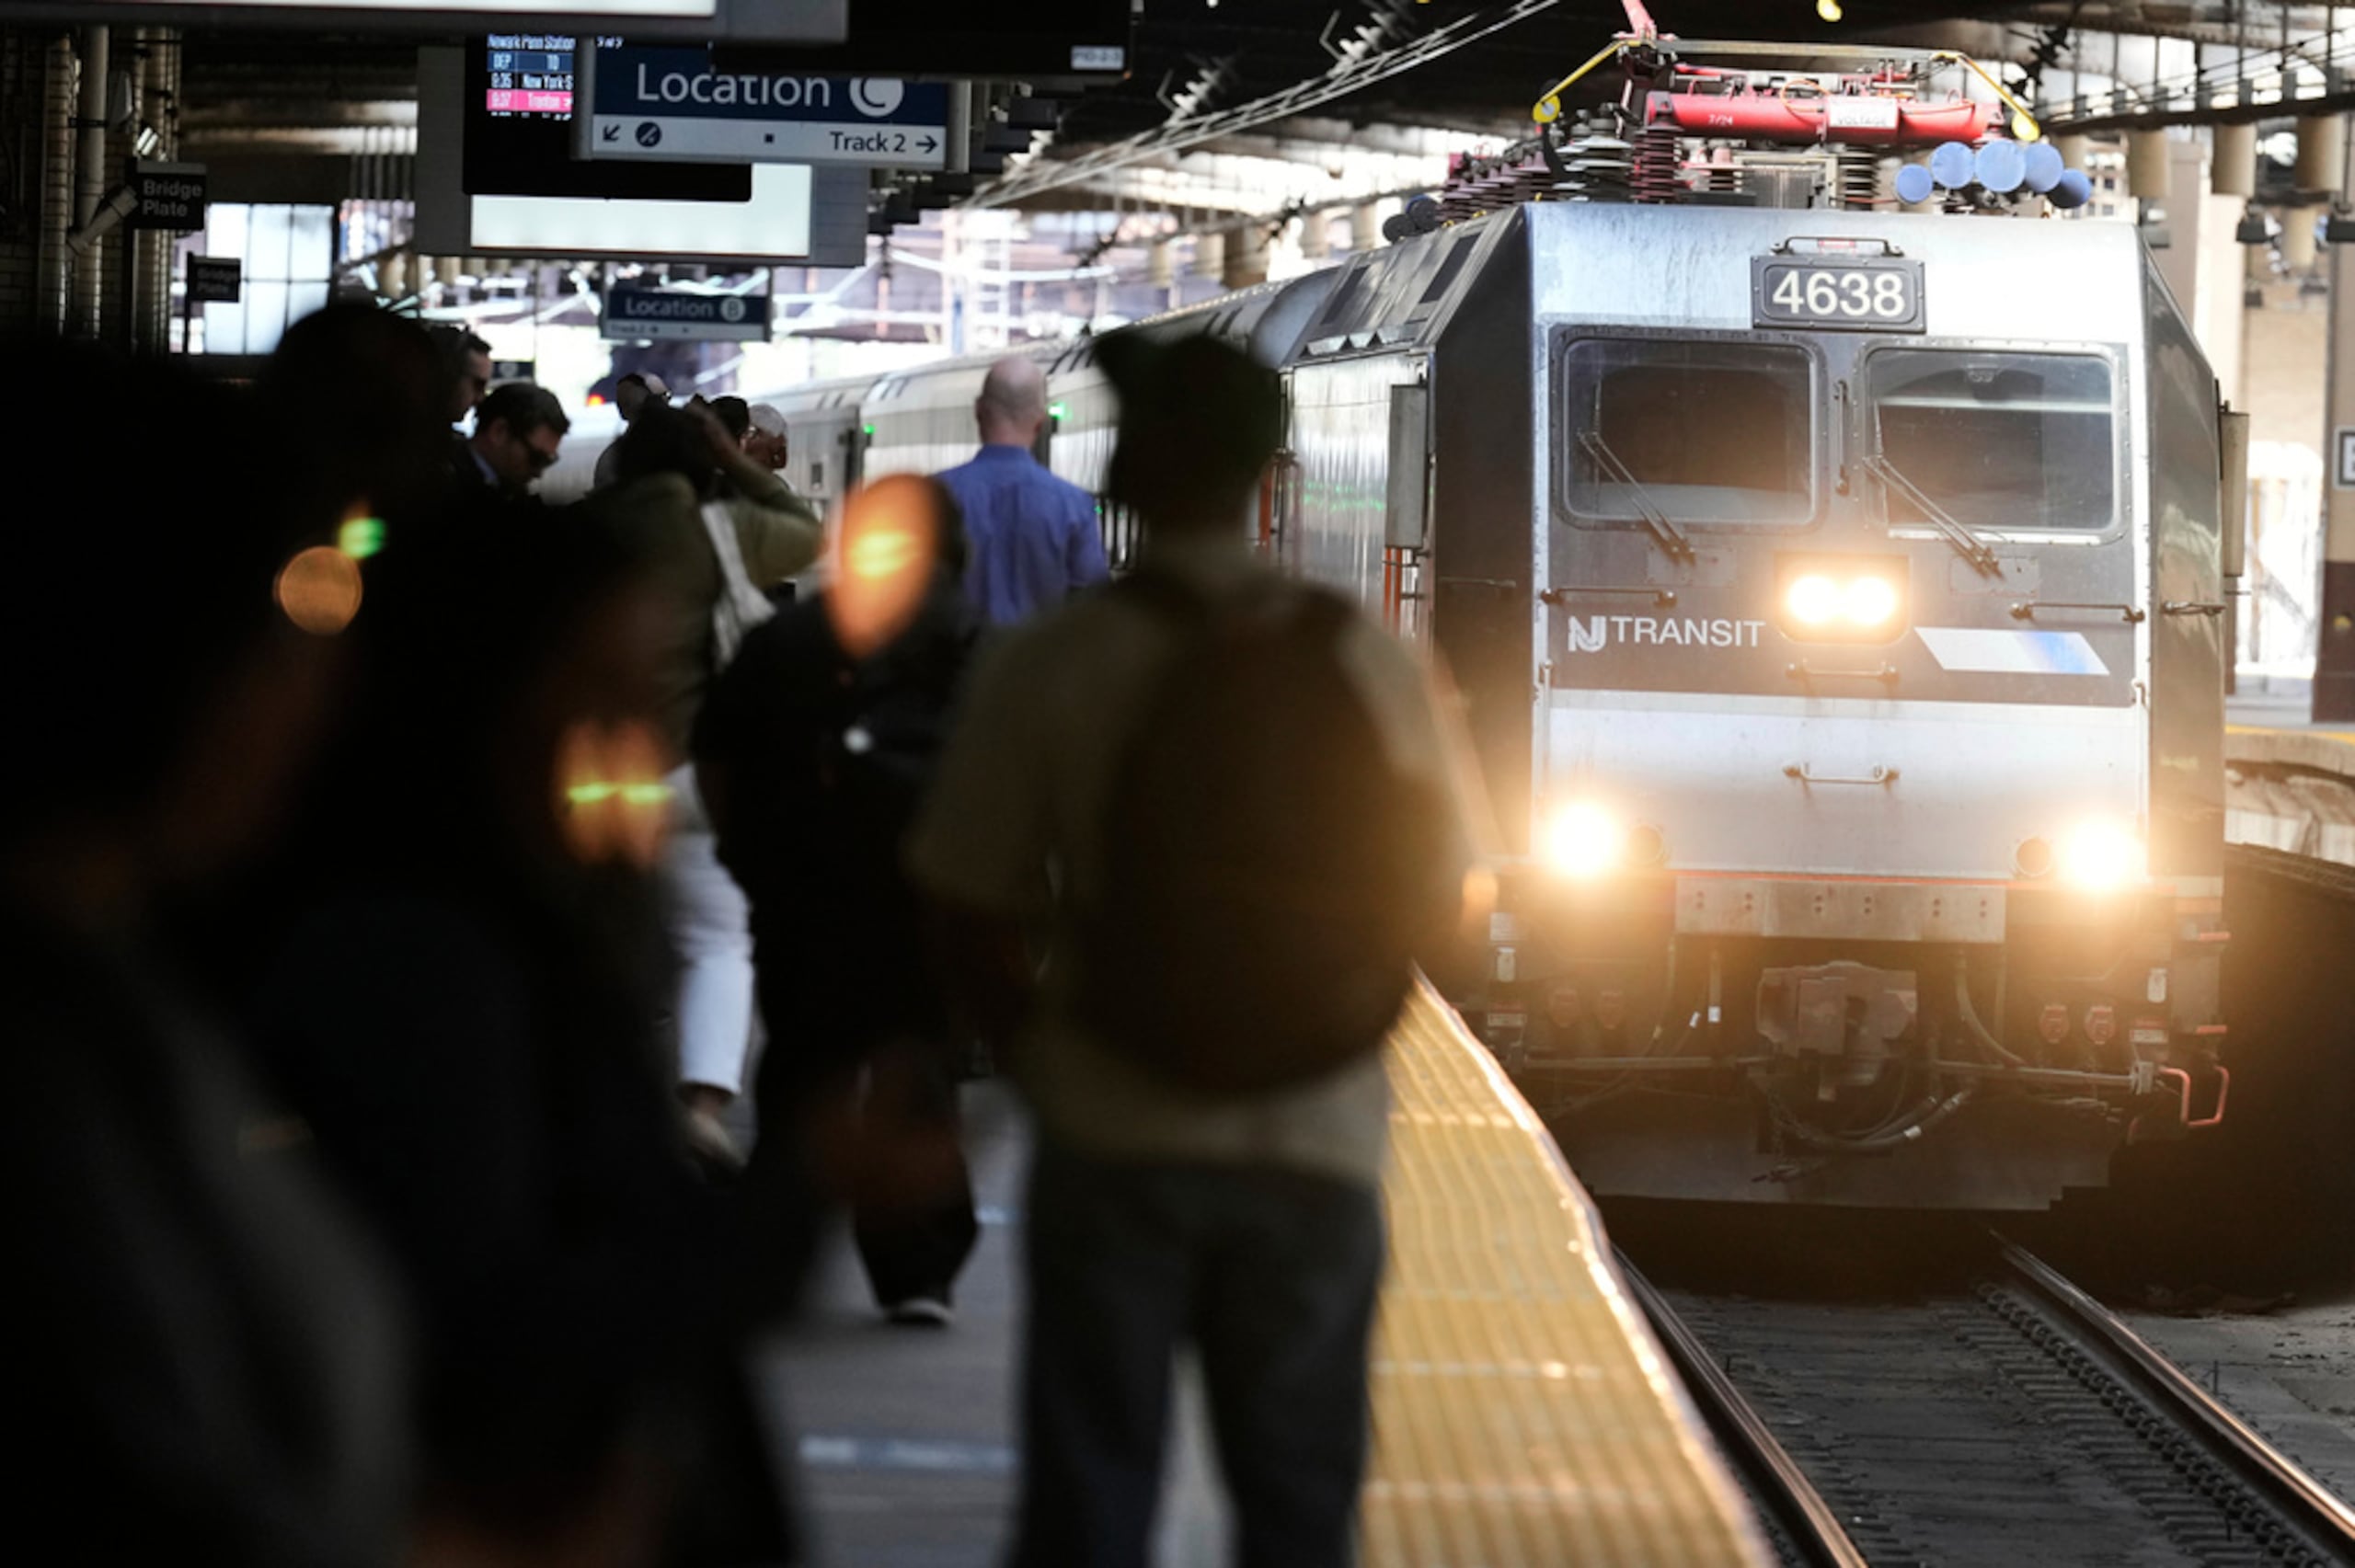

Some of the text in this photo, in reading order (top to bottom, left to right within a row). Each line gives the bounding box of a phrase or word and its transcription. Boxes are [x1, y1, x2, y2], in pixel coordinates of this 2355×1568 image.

[638, 63, 830, 108] Location
[830, 132, 906, 153] Track 2
[144, 179, 202, 200] Bridge
[143, 199, 189, 216] Plate
[1772, 269, 1906, 318] 4638
[626, 297, 714, 318] Location
[1568, 615, 1766, 652] NJ TRANSIT
